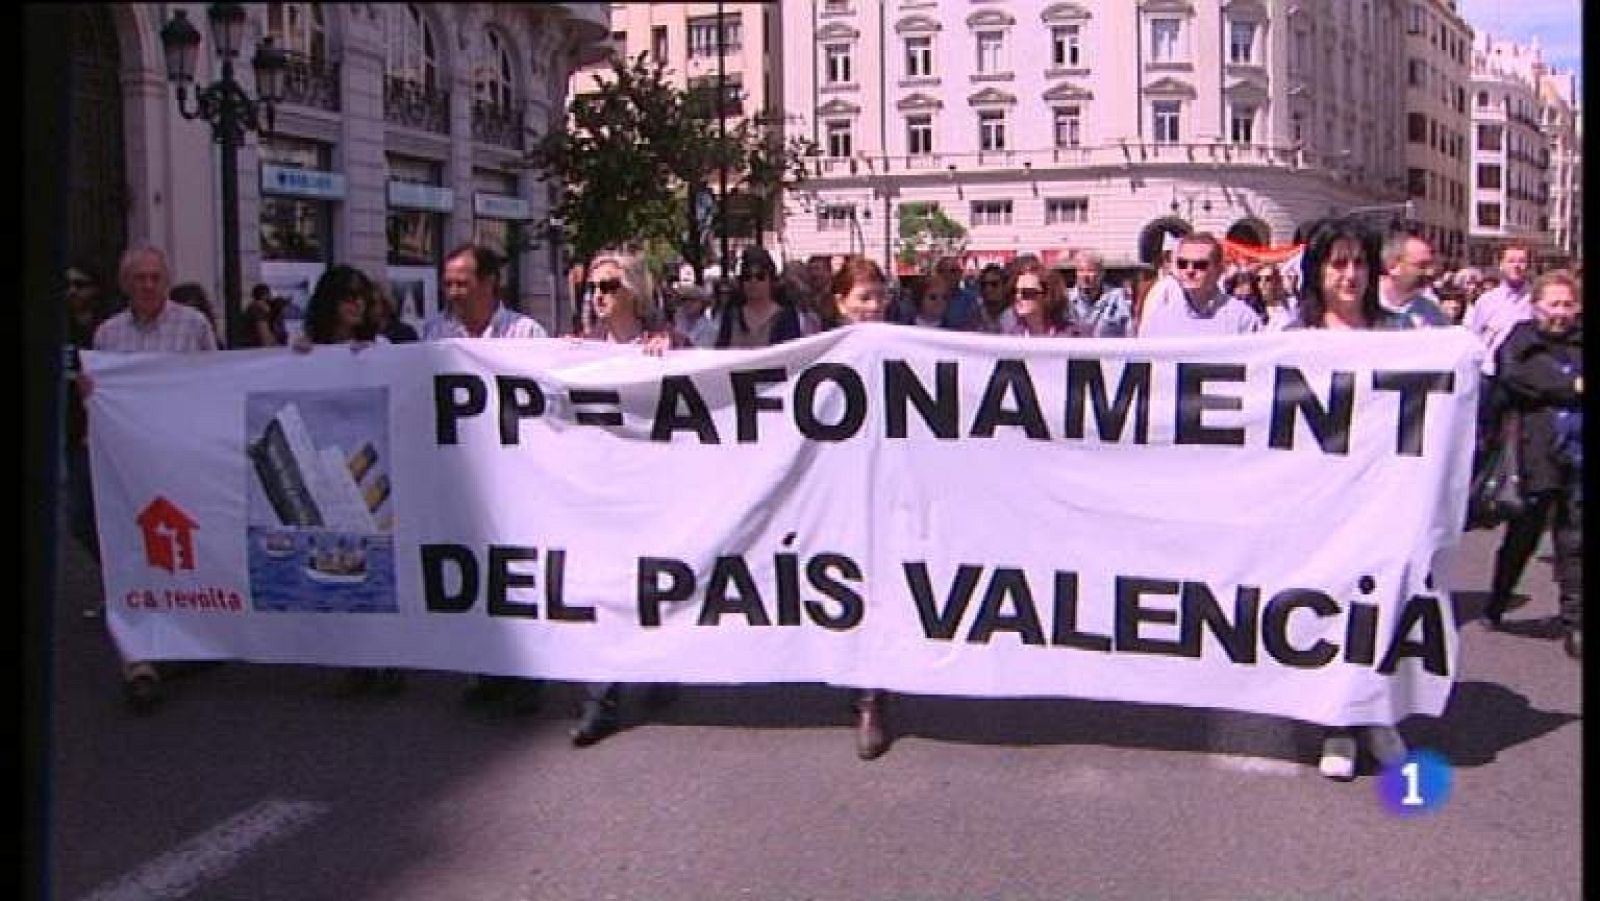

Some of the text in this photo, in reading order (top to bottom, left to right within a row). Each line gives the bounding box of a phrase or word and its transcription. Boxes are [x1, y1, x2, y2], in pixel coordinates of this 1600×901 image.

[433, 373, 546, 445] PP
[649, 359, 1456, 458] AFONAMENT
[419, 543, 597, 623] DEL
[637, 531, 866, 632] PAÍS
